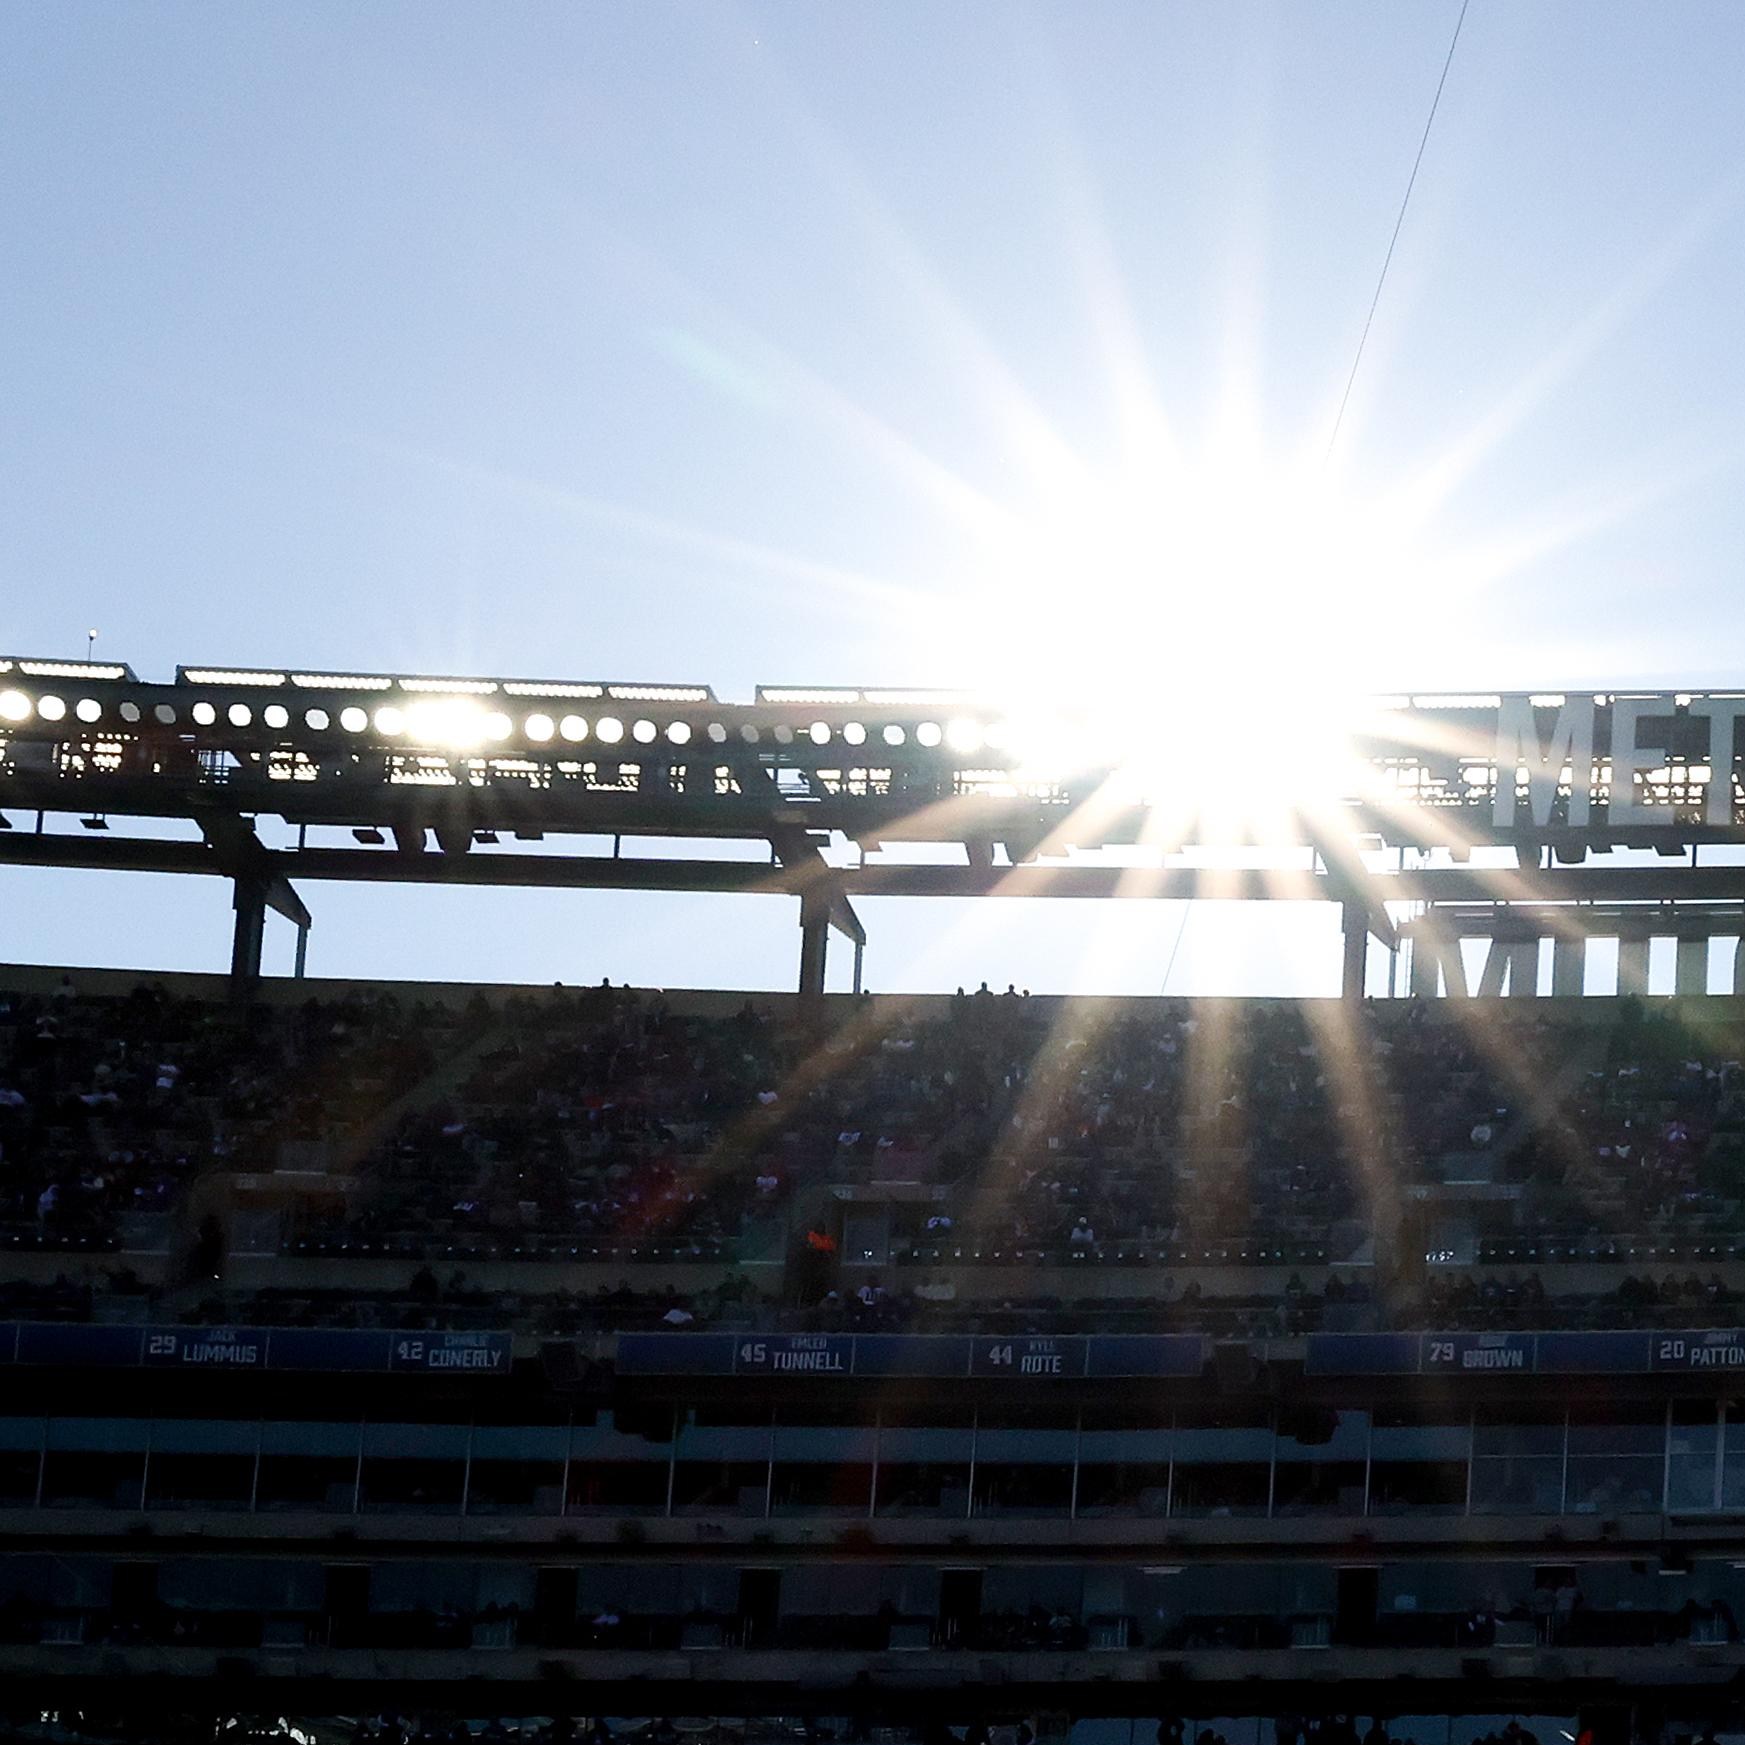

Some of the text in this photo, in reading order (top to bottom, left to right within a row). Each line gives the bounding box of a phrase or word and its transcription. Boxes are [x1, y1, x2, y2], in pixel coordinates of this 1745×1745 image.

[183, 1344, 257, 1364] LUMMUS
[428, 1349, 502, 1368] CONERLY
[1462, 1350, 1523, 1368] BROWN
[1659, 1341, 1685, 1360] 20
[772, 1352, 844, 1371] TUNNELL
[1021, 1355, 1063, 1374] ROTE
